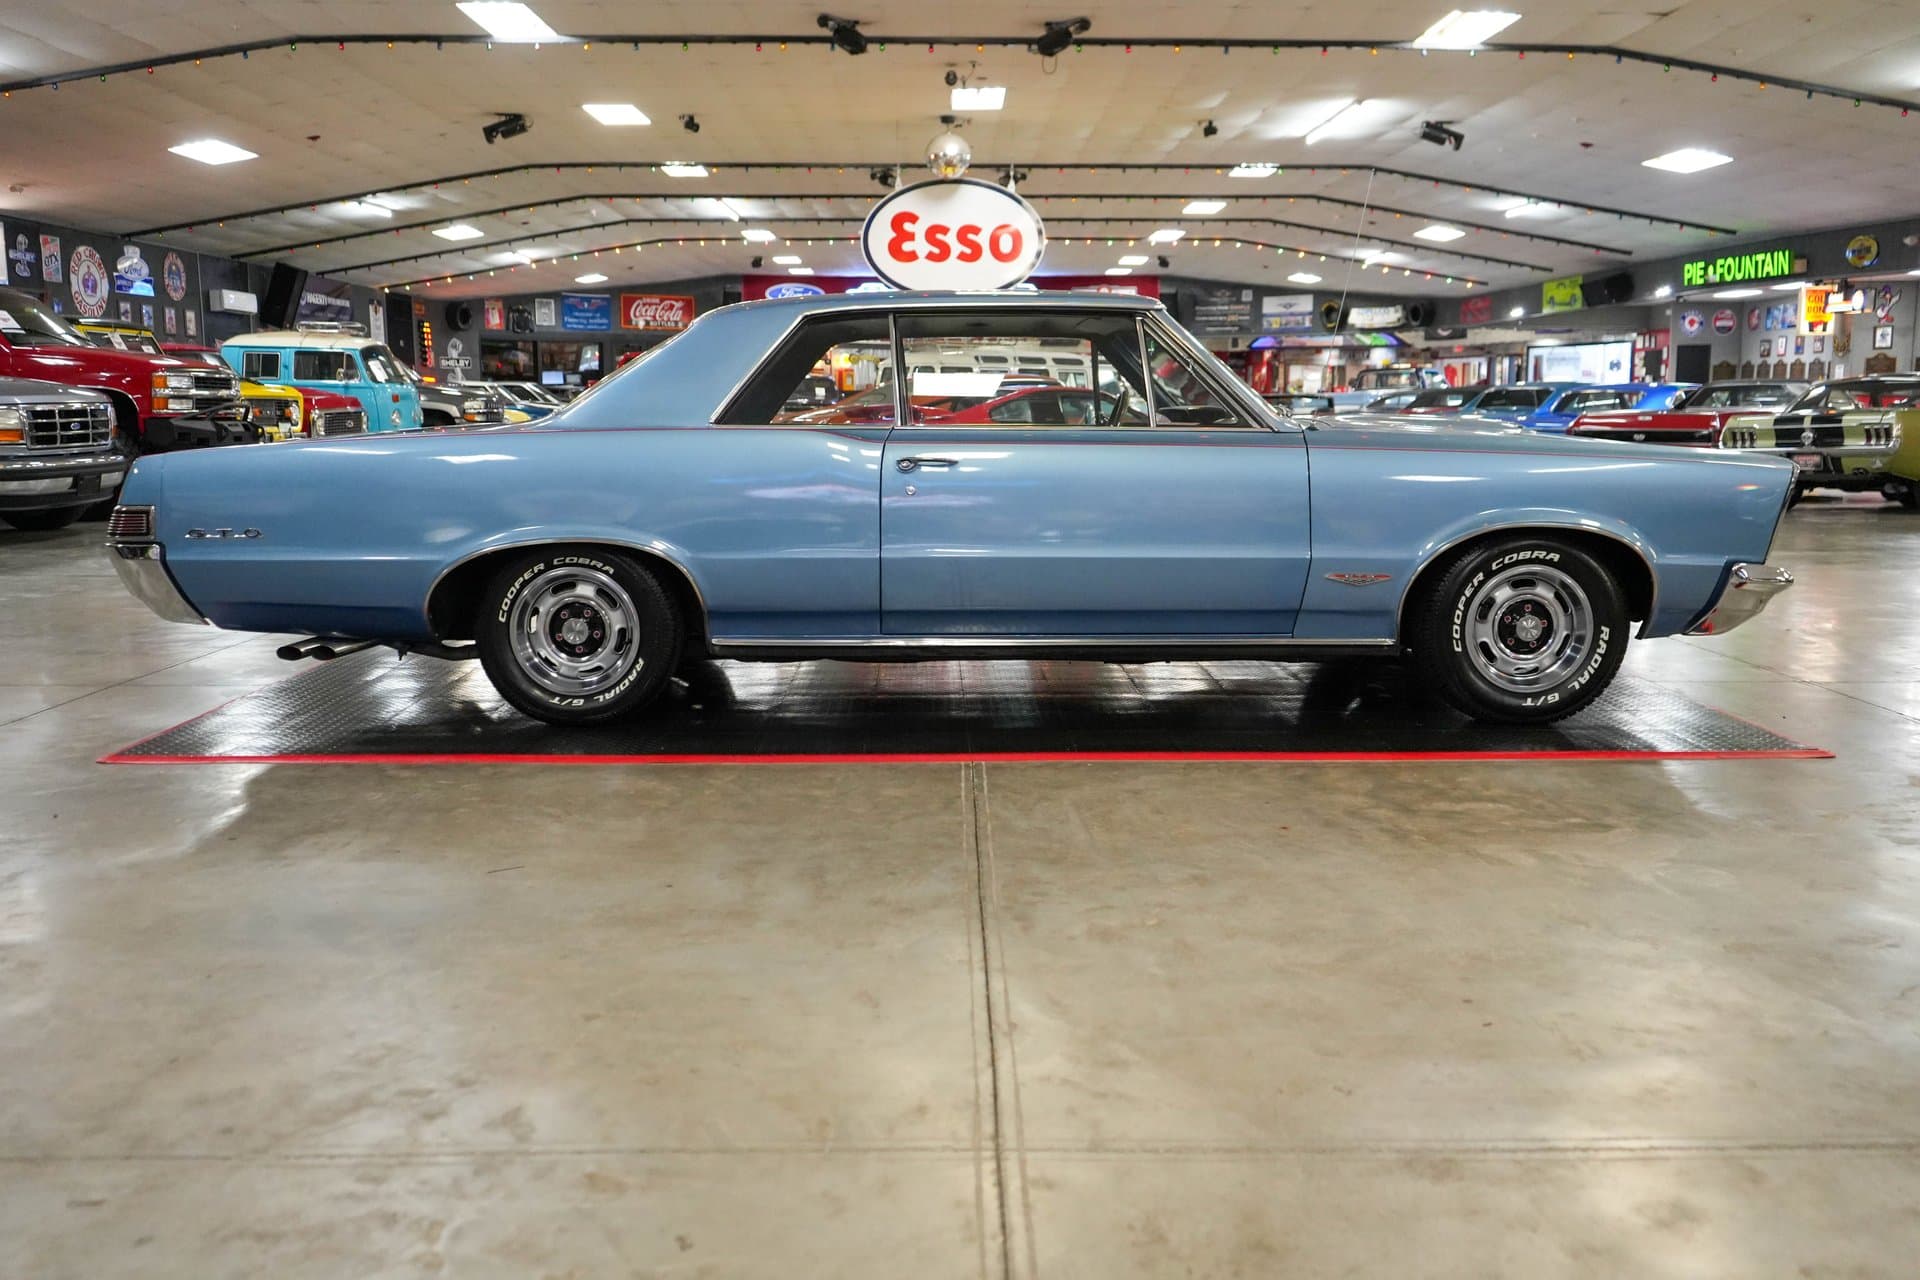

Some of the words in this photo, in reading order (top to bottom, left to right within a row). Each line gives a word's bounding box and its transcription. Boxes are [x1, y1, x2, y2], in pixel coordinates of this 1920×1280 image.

[888, 211, 1023, 263] Esso
[71, 251, 82, 276] RED
[83, 247, 106, 279] CROWN
[1683, 261, 1705, 286] PIE
[1716, 250, 1790, 282] FOUNTAIN
[440, 359, 470, 367] SHELBY
[498, 562, 545, 623] COOPER
[552, 556, 615, 575] COBRA
[1452, 571, 1485, 653] COOPER
[1491, 550, 1561, 571] COBRA
[593, 657, 645, 702] RADIAL
[1567, 625, 1611, 691] RADIAL
